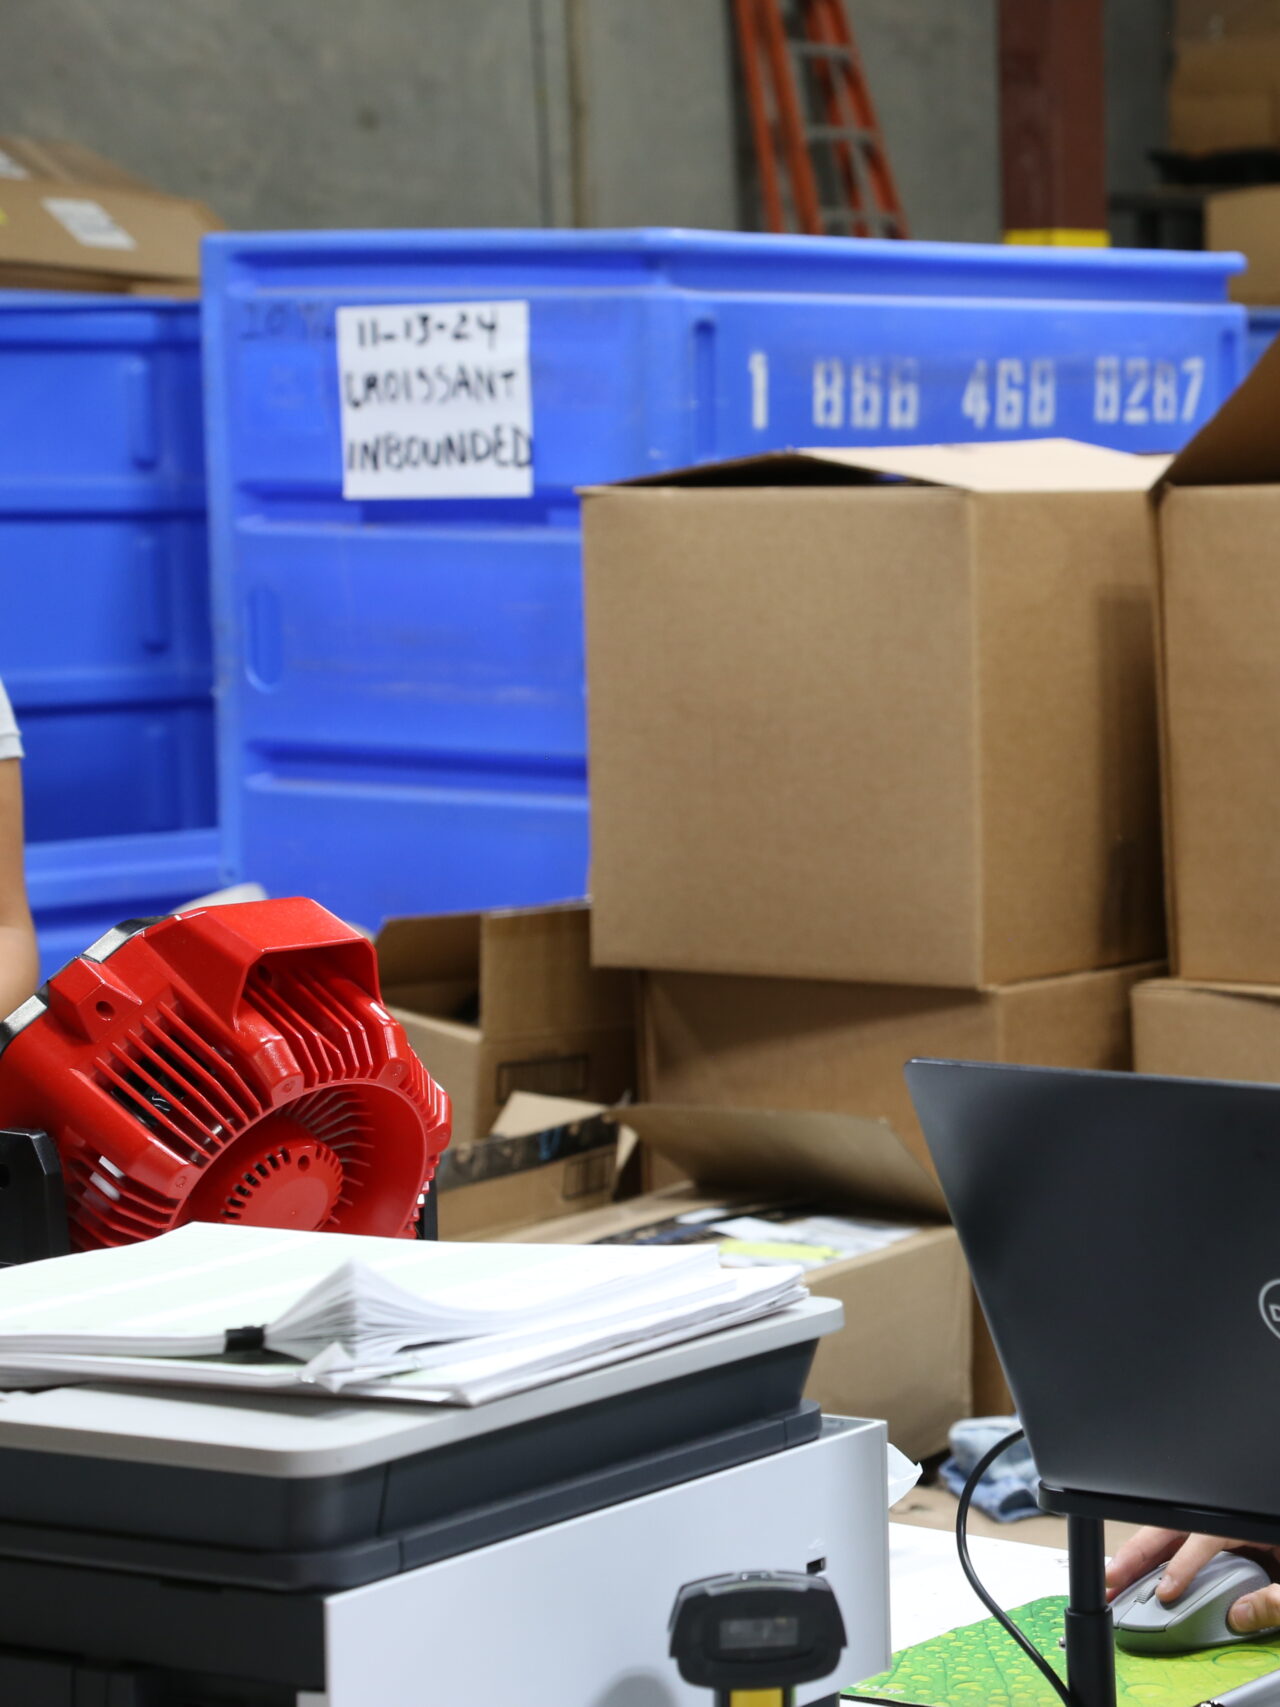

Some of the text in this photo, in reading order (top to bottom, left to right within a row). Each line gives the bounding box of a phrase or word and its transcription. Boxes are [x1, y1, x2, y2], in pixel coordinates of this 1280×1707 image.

[357, 310, 498, 350] 11-13-24
[344, 362, 518, 411] CROISSANT
[748, 351, 769, 431] 1
[347, 426, 534, 472] INBOUNDED
